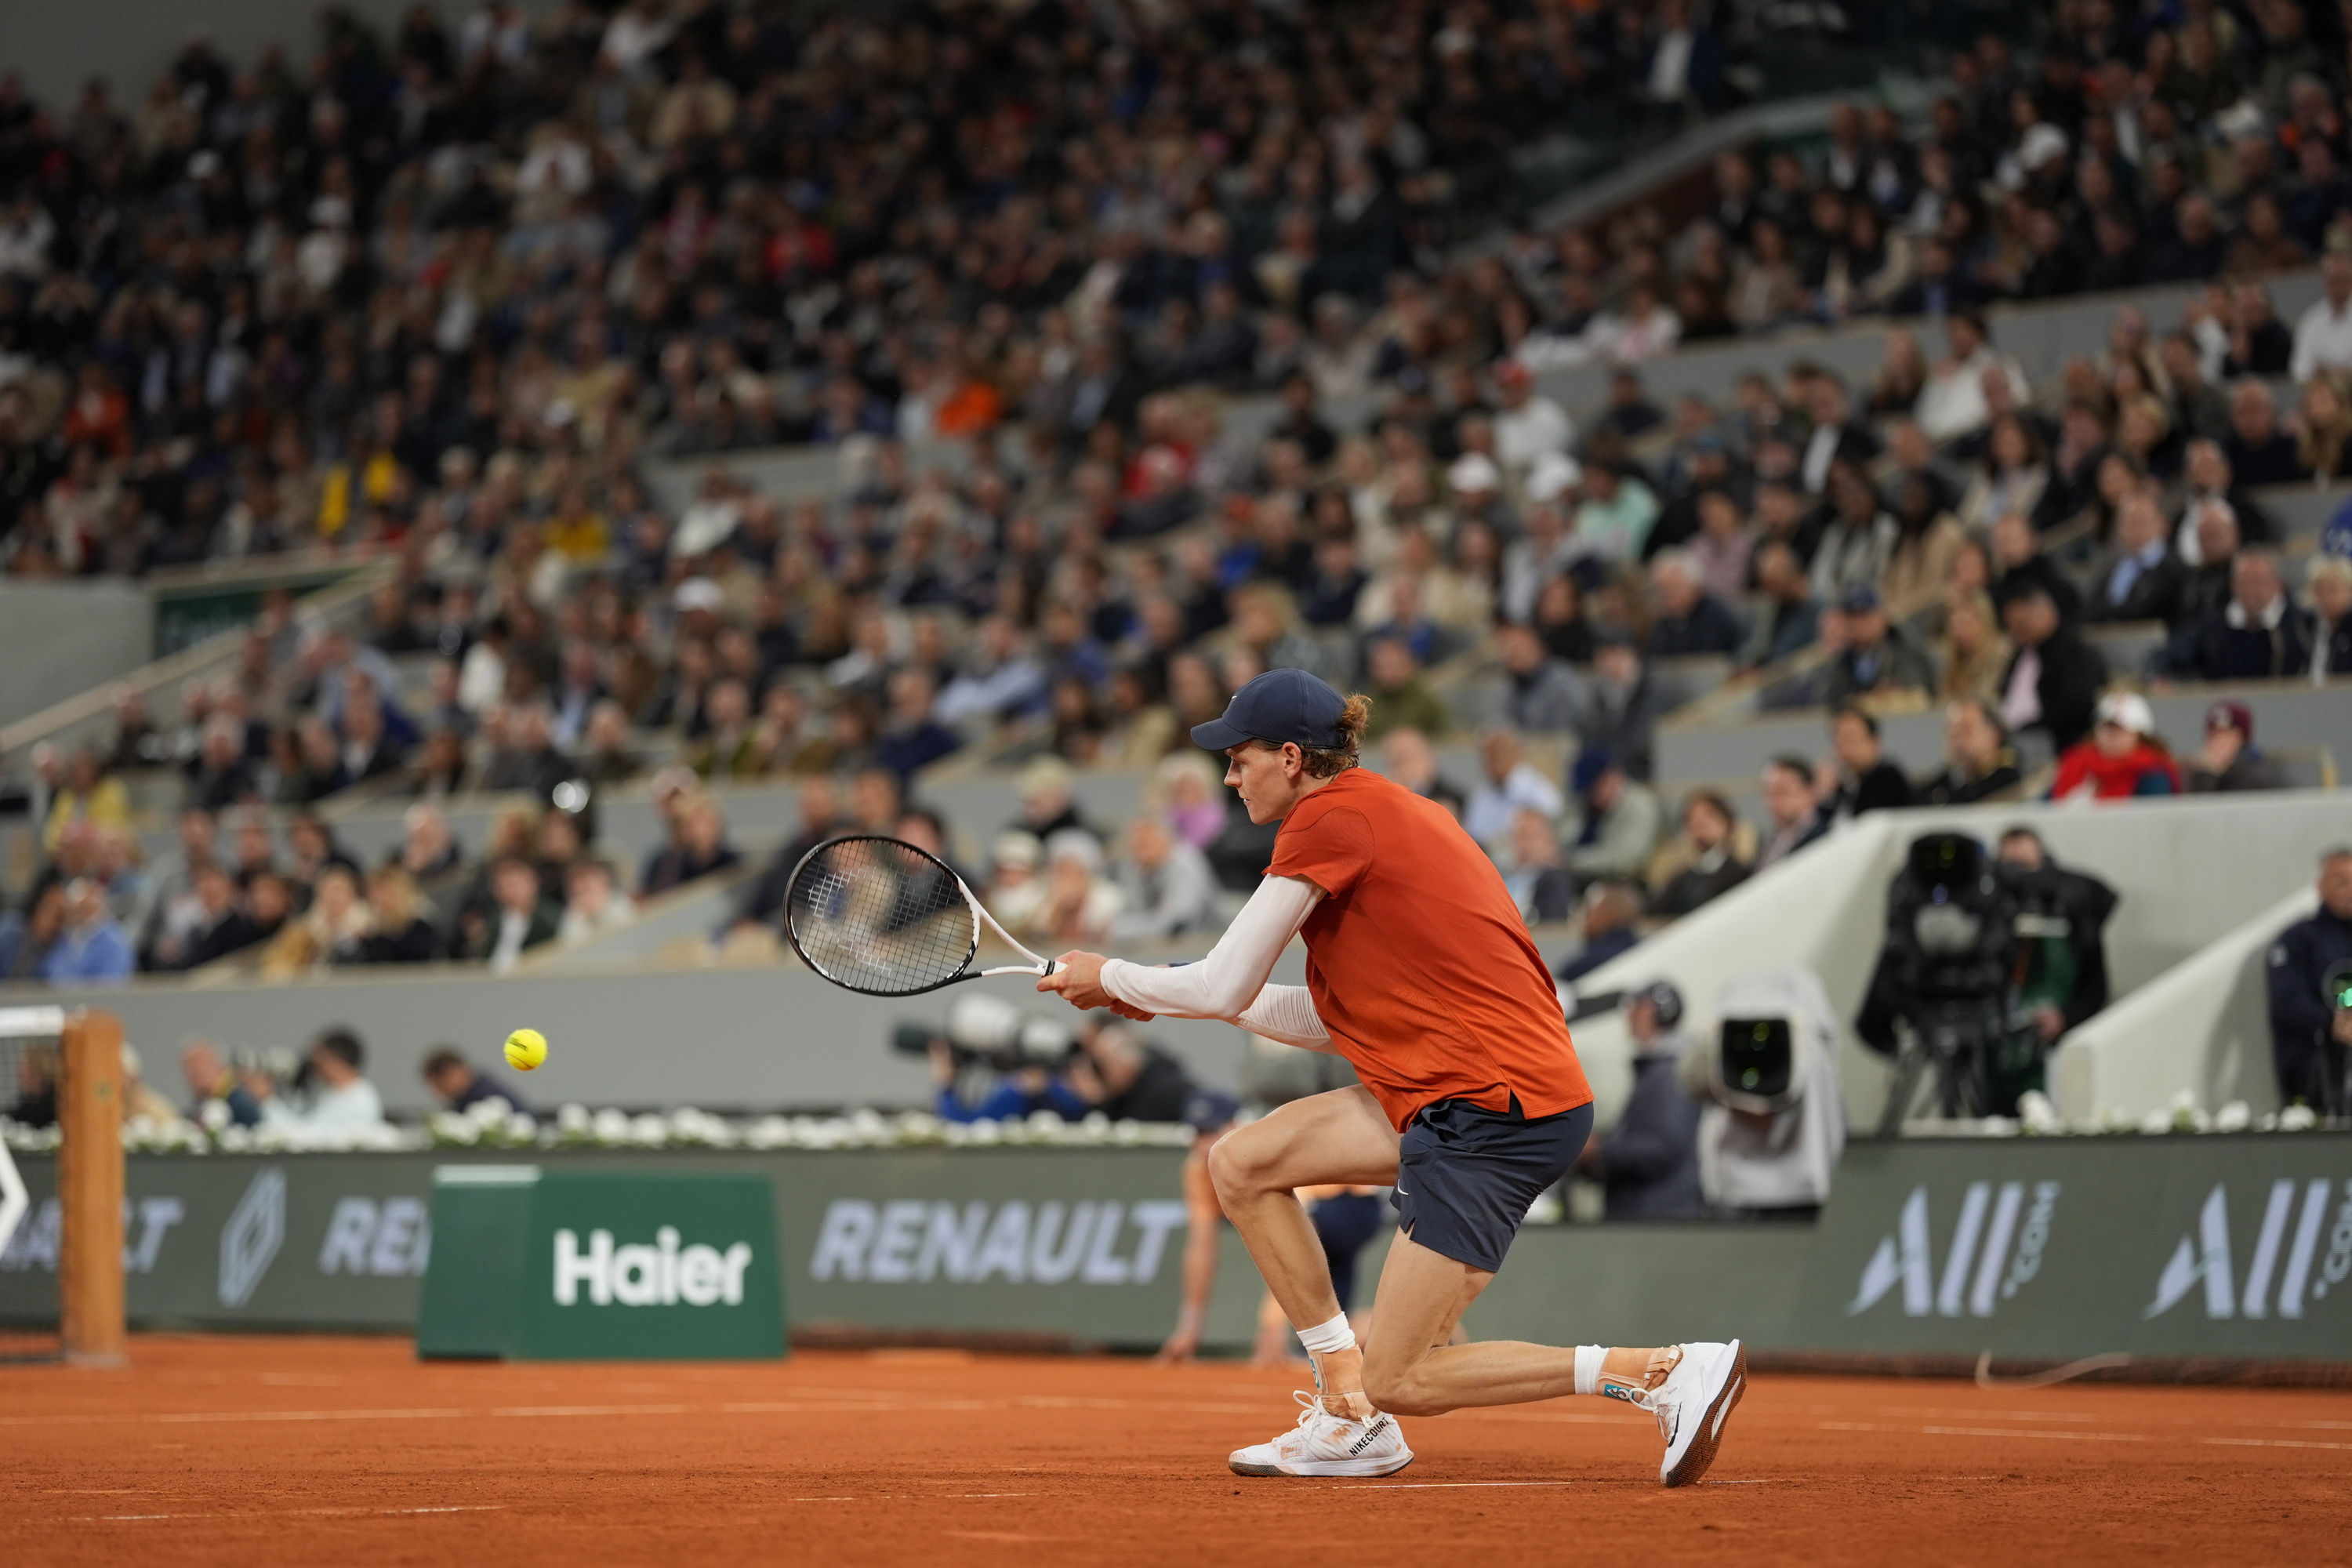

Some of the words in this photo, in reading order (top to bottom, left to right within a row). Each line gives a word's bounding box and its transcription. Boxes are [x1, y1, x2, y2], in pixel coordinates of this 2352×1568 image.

[554, 1225, 752, 1307] Haier
[811, 1198, 1186, 1284] RENAULT
[1348, 1417, 1388, 1457] NIKECOURT
